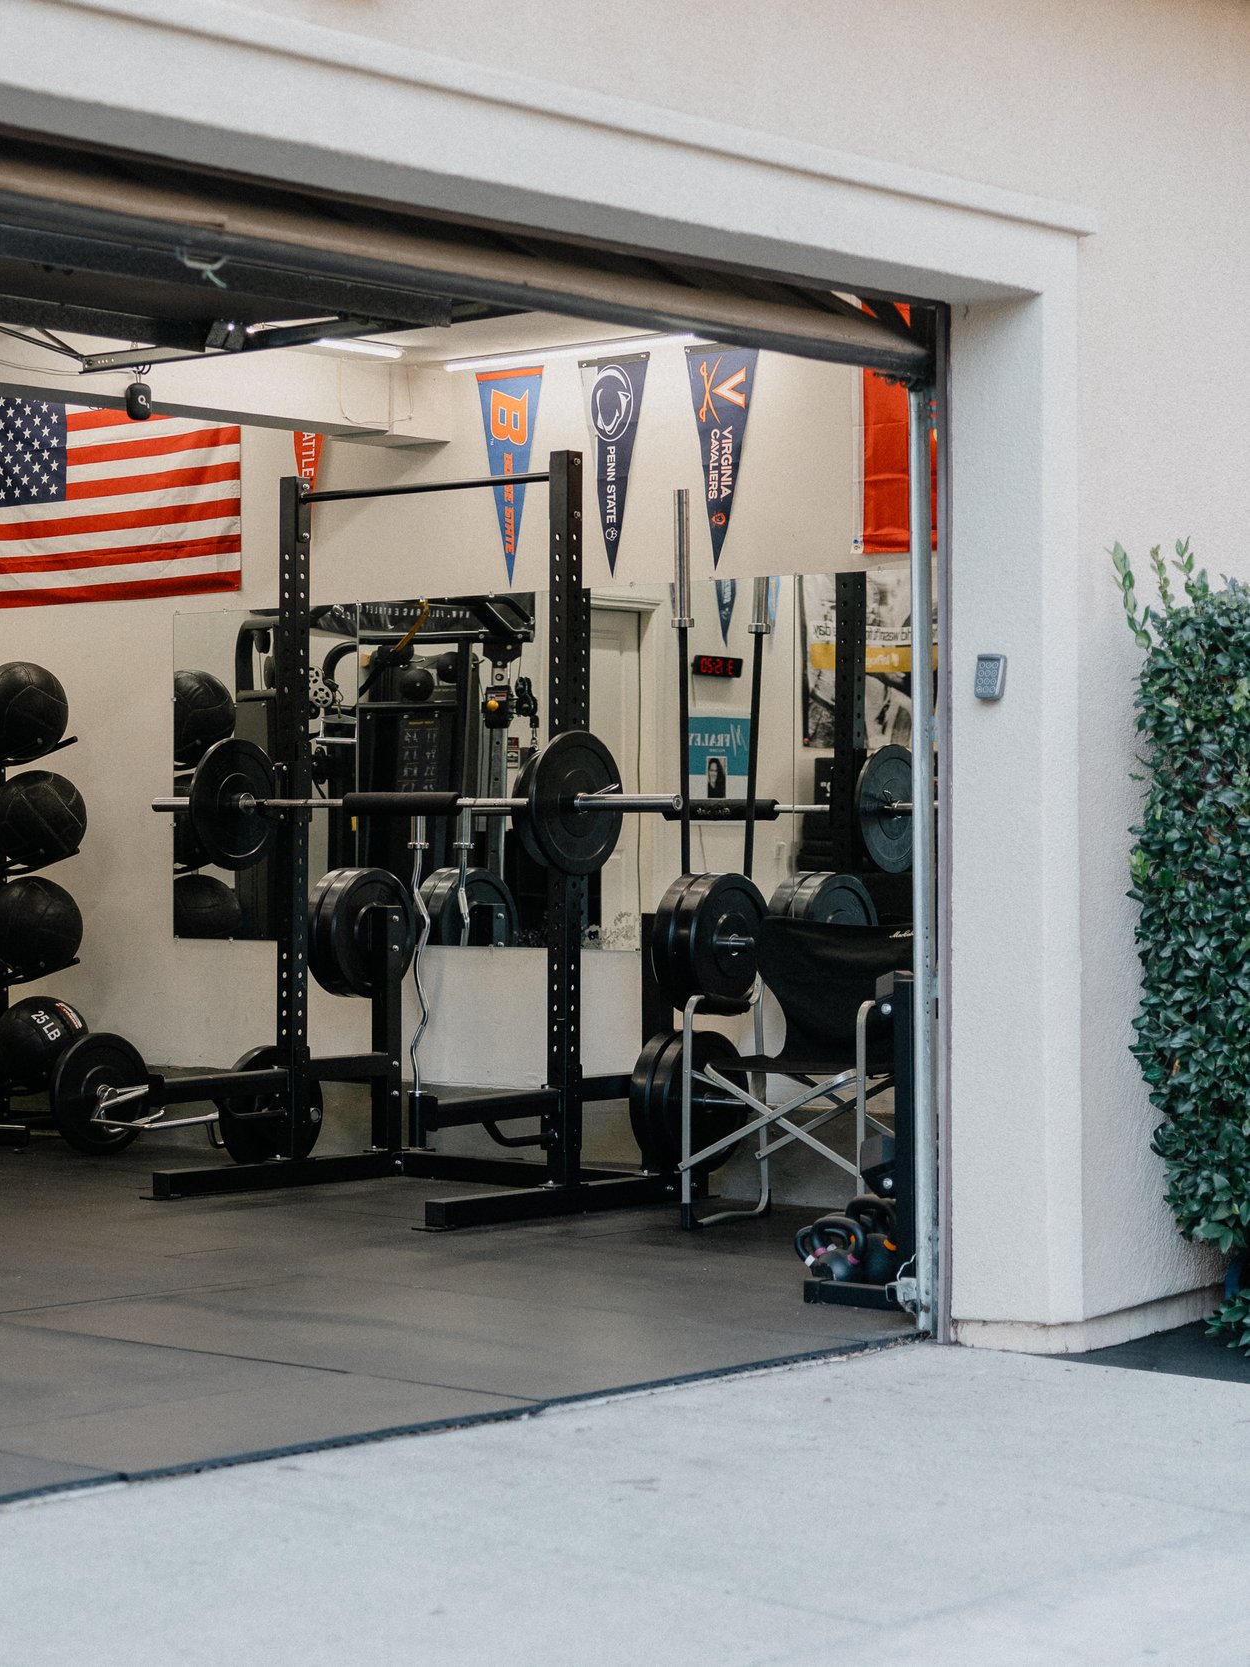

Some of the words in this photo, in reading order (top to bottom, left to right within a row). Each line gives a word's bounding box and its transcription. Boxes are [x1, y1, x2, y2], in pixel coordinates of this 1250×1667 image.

[503, 452, 514, 504] BOSE
[606, 445, 616, 482] PENN
[708, 428, 720, 500] CAVALIERS
[720, 425, 733, 499] VIRGINIA
[606, 484, 616, 524] STATE
[504, 506, 515, 556] STATE
[31, 1010, 50, 1024] 25
[42, 1022, 62, 1041] LB
